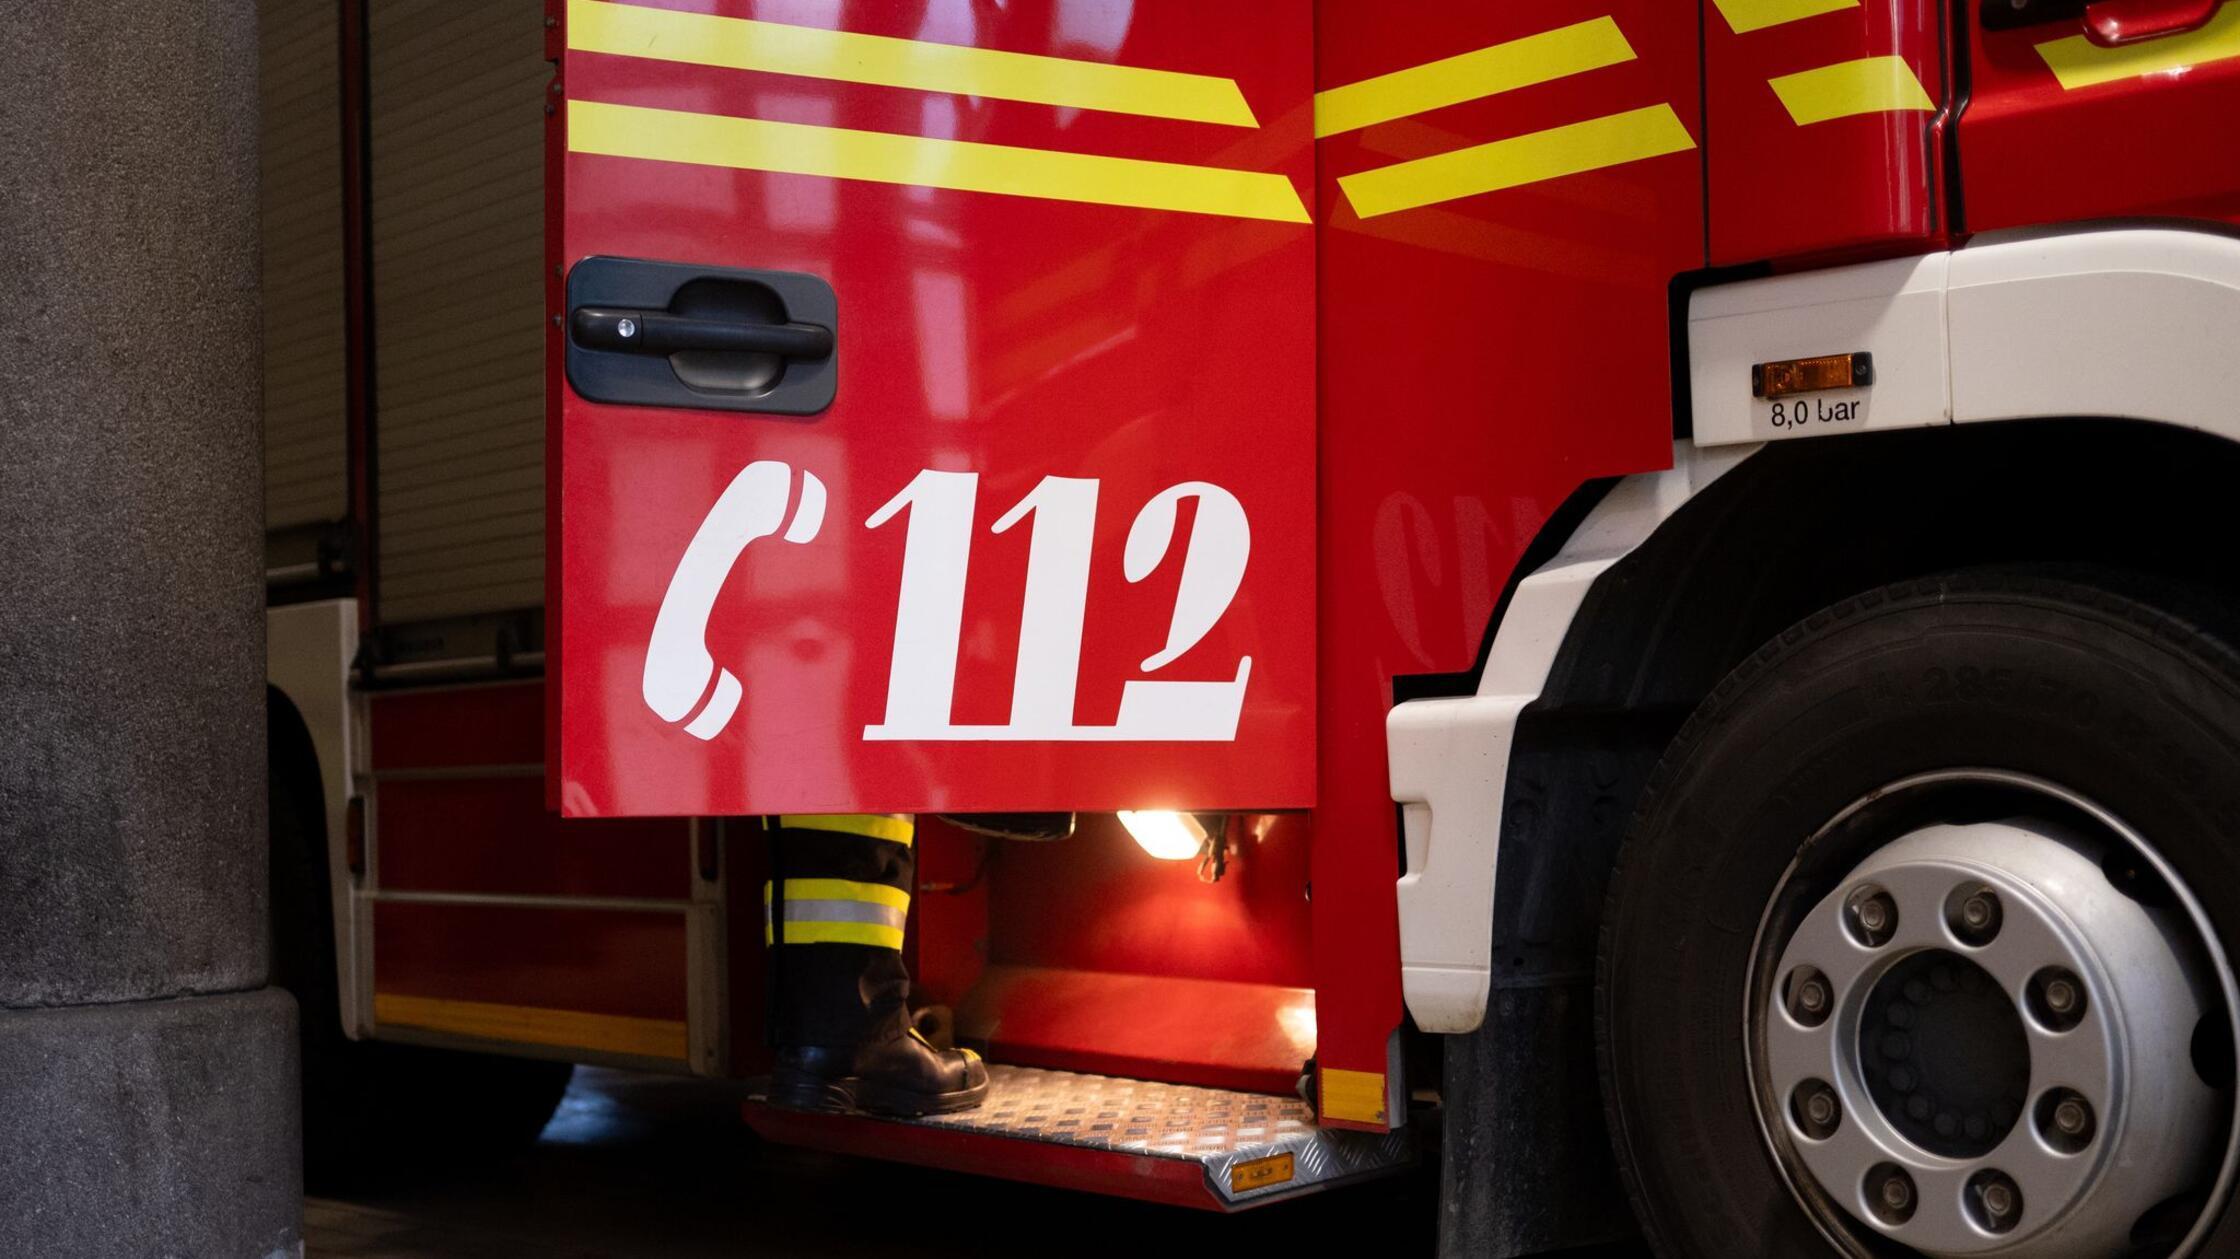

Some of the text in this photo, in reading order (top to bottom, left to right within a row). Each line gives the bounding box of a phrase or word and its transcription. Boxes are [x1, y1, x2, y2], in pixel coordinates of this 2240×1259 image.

[1770, 398, 1861, 431] 8,0 bar
[862, 469, 1252, 741] 112
